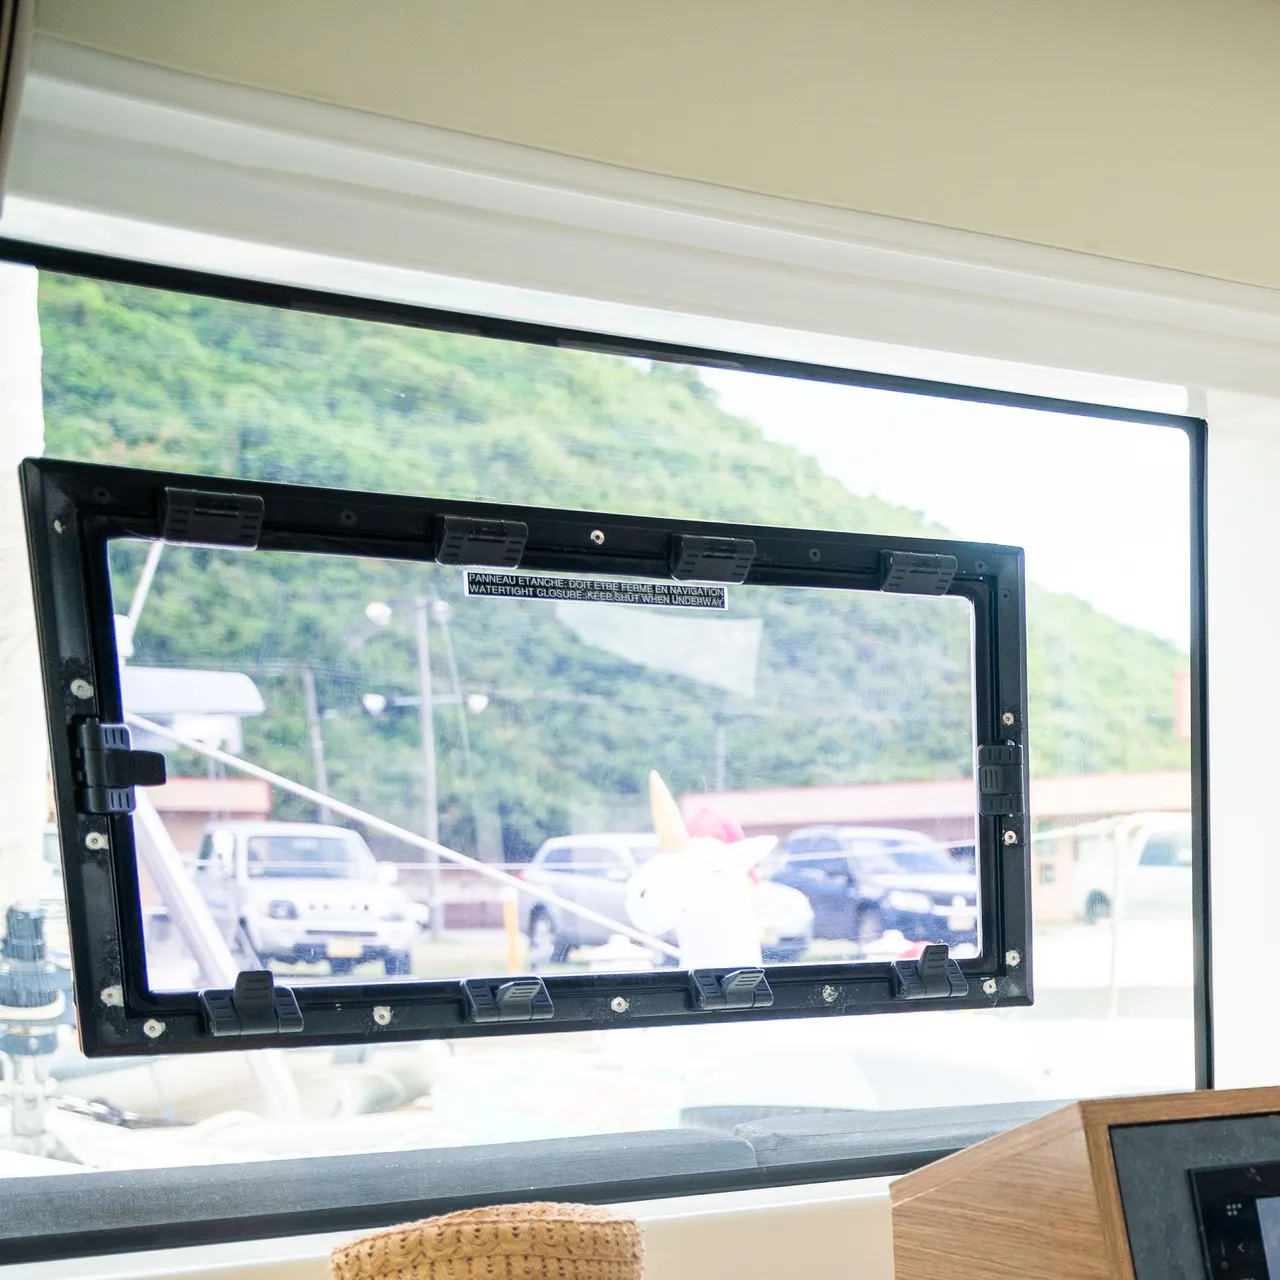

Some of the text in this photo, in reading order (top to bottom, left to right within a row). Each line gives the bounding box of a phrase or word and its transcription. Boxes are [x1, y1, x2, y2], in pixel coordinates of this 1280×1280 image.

[469, 573, 724, 598] PANNEAU ETANCHE: DOIT ETRE FERME EN NAVIGATION
[469, 584, 535, 597] WATERTIGHT
[587, 591, 613, 601] KEEP
[614, 592, 639, 603] SHUT
[641, 593, 670, 604] WHEN
[671, 595, 724, 607] UNDERWAY
